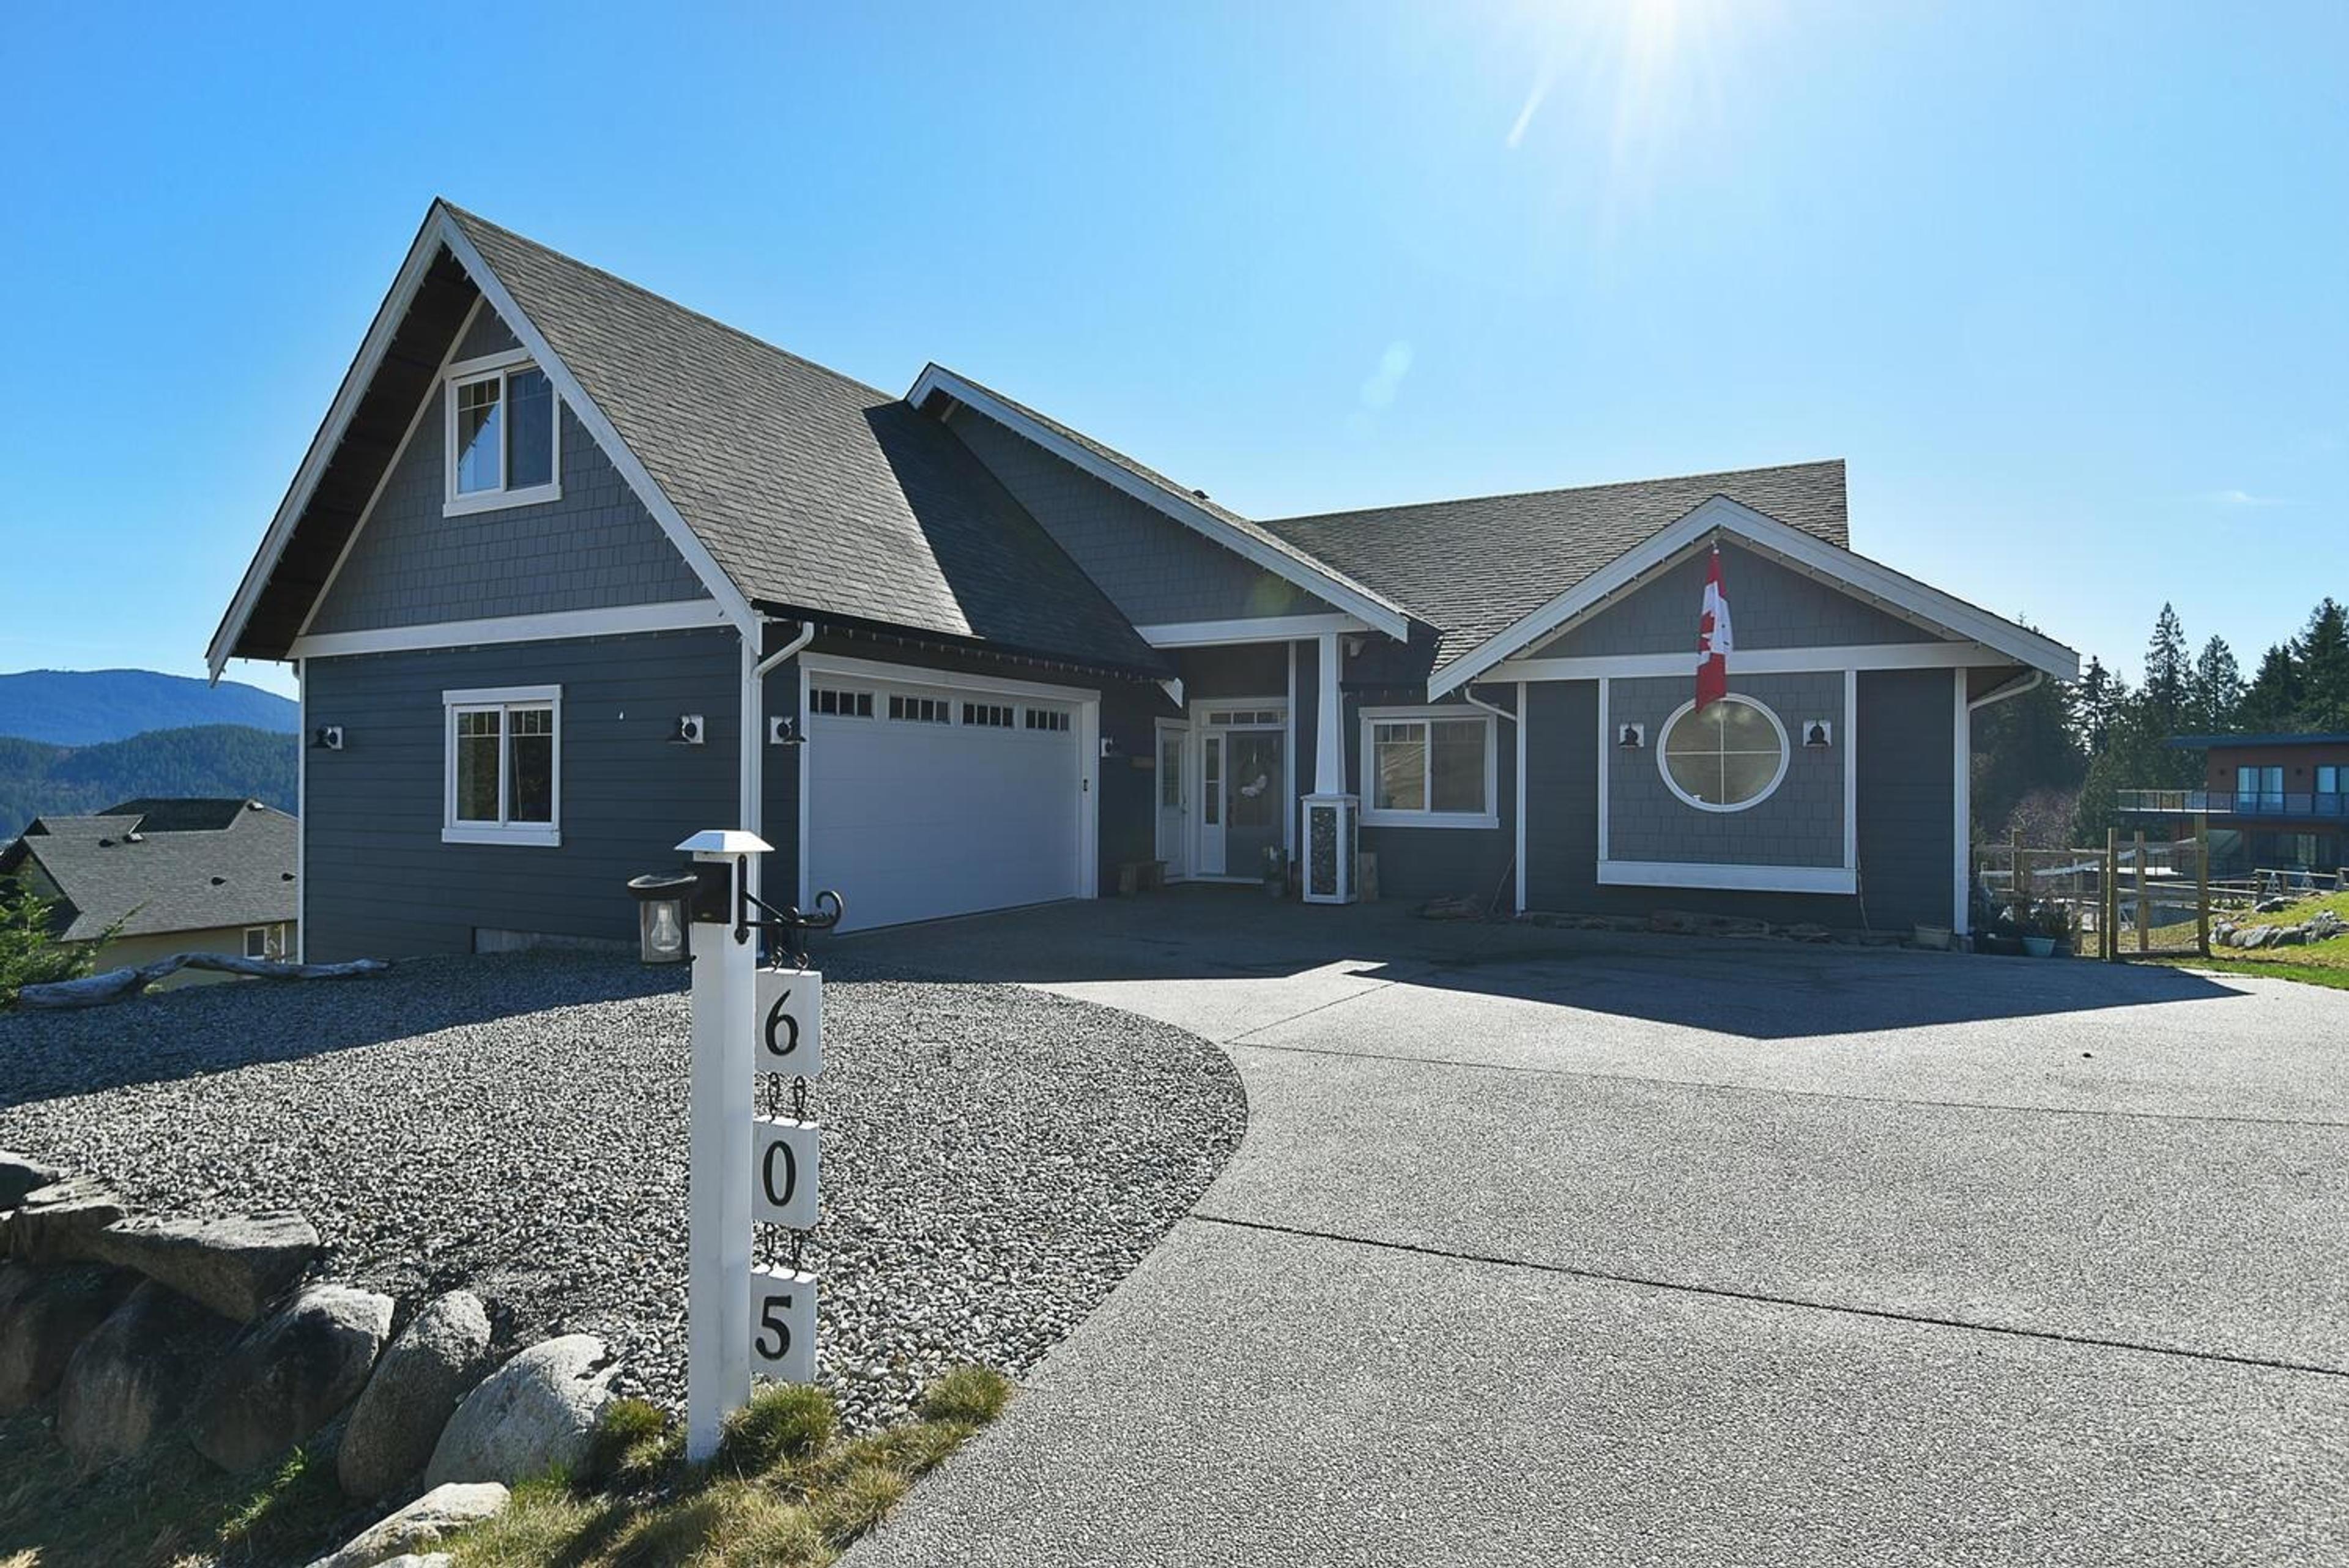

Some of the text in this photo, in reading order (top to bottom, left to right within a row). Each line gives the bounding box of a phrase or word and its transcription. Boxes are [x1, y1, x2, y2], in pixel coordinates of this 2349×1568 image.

[765, 989, 799, 1057] 6
[762, 1140, 796, 1207] 0
[755, 1295, 793, 1361] 5
